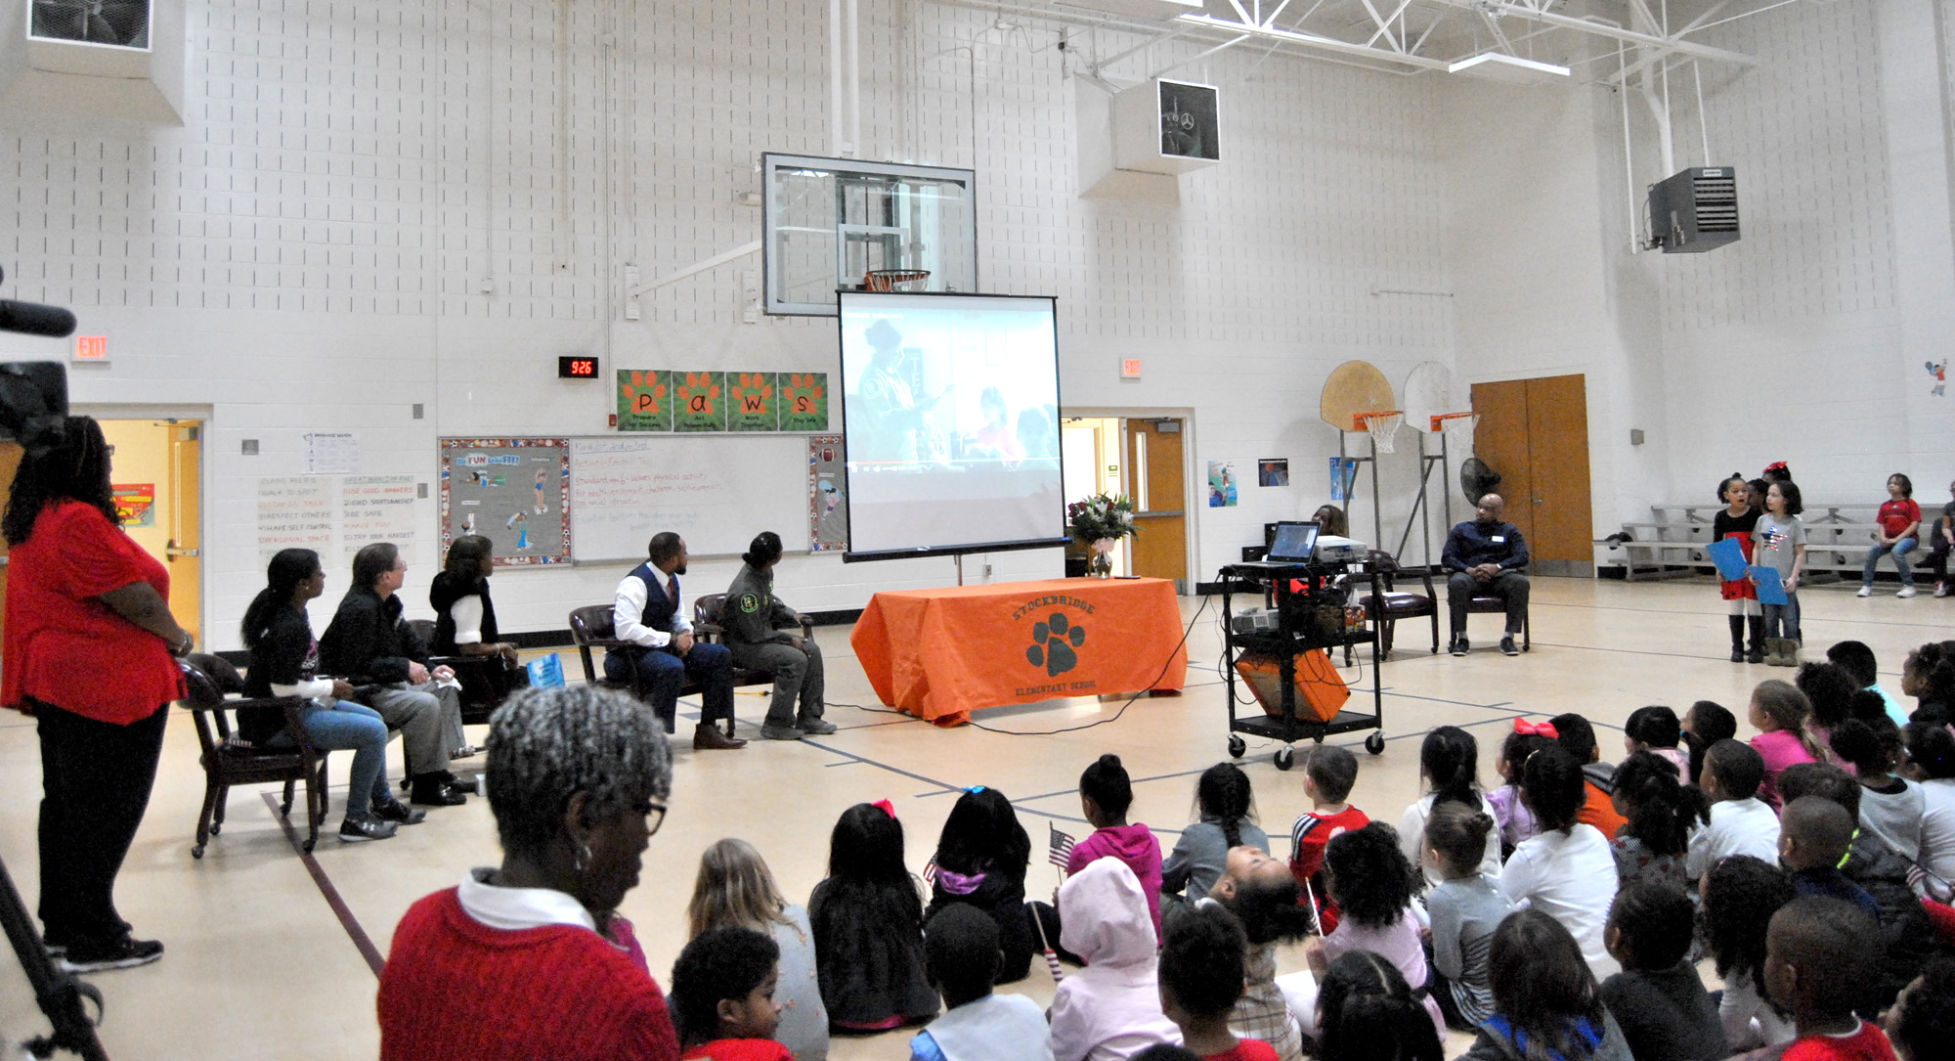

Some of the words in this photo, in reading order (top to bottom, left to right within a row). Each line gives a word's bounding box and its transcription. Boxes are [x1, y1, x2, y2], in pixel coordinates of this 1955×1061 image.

[78, 336, 108, 358] EXIT
[468, 455, 486, 464] FUN
[1012, 595, 1096, 620] STOCKBRIDGE
[1015, 683, 1067, 696] ELEMENTARY
